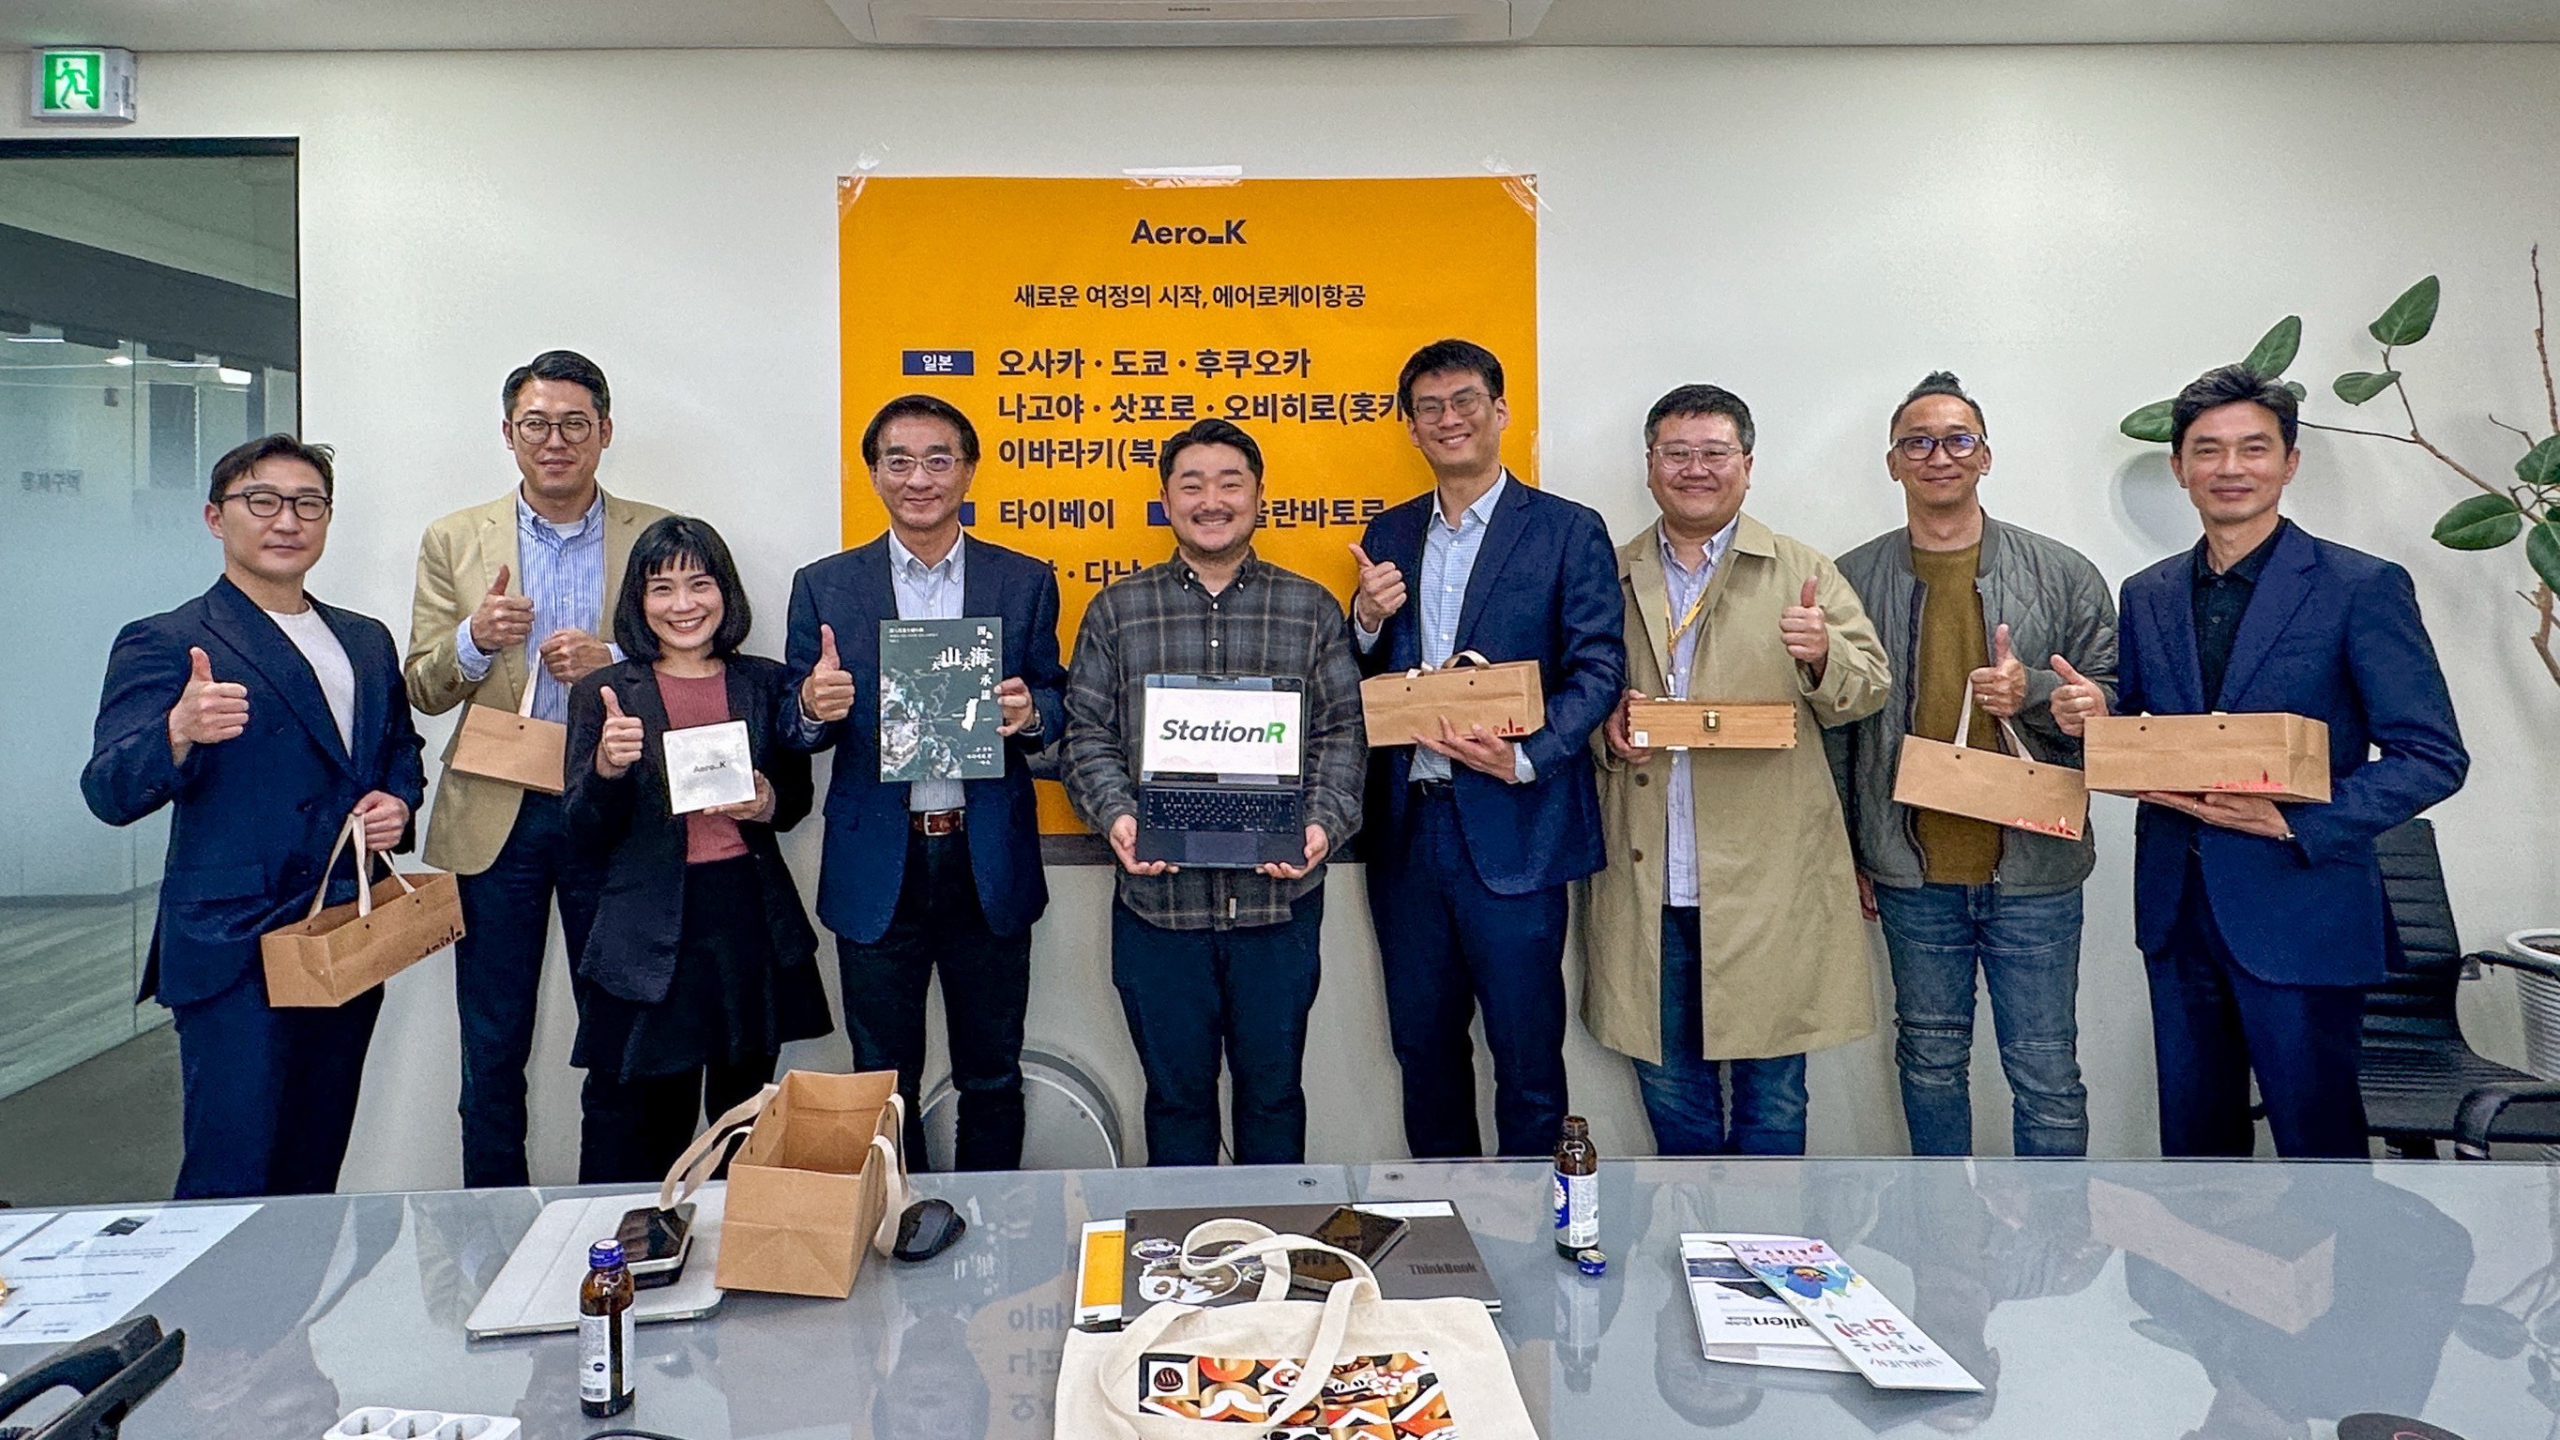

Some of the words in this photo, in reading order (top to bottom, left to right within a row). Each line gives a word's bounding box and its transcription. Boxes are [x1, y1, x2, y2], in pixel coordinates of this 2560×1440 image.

[1014, 284, 1080, 309] 새로운
[1086, 284, 1151, 309] 여정의
[1158, 284, 1208, 309] 시작,
[1212, 284, 1366, 309] 에어로케이항공
[922, 353, 954, 372] 일본
[998, 348, 1086, 379] 오사카
[1111, 350, 1169, 376] 도쿄
[1194, 347, 1312, 379] 후쿠오카
[998, 393, 1085, 424] 나고야
[1110, 393, 1197, 423] 삿포로
[1223, 392, 1404, 426] 오비히로(홋카
[998, 438, 1162, 472] 이바라키(북
[1000, 498, 1114, 530] 타이베이
[1160, 719, 1287, 744] StationR
[1409, 1262, 1477, 1275] ThinkBook
[1753, 1316, 1810, 1329] alien
